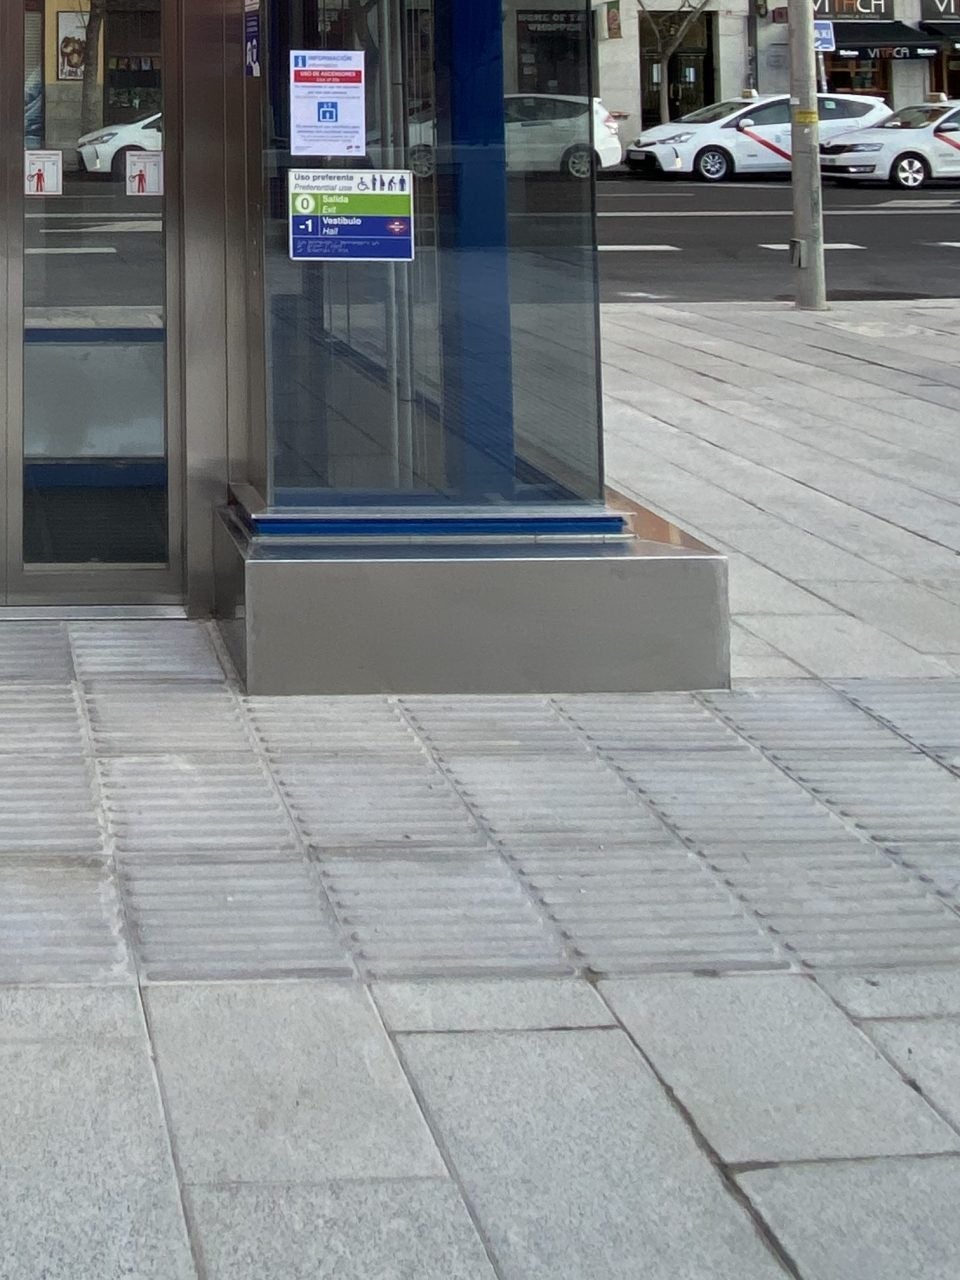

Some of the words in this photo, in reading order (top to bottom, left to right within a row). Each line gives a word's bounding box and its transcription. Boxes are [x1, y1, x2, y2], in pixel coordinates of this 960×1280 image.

[868, 47, 910, 58] VITACA
[294, 173, 310, 181] Uso
[313, 174, 353, 182] preferente
[322, 195, 348, 203] Salida
[301, 198, 309, 210] 0
[322, 205, 336, 214] Exit
[299, 219, 312, 232] -1
[322, 227, 338, 235] Hall
